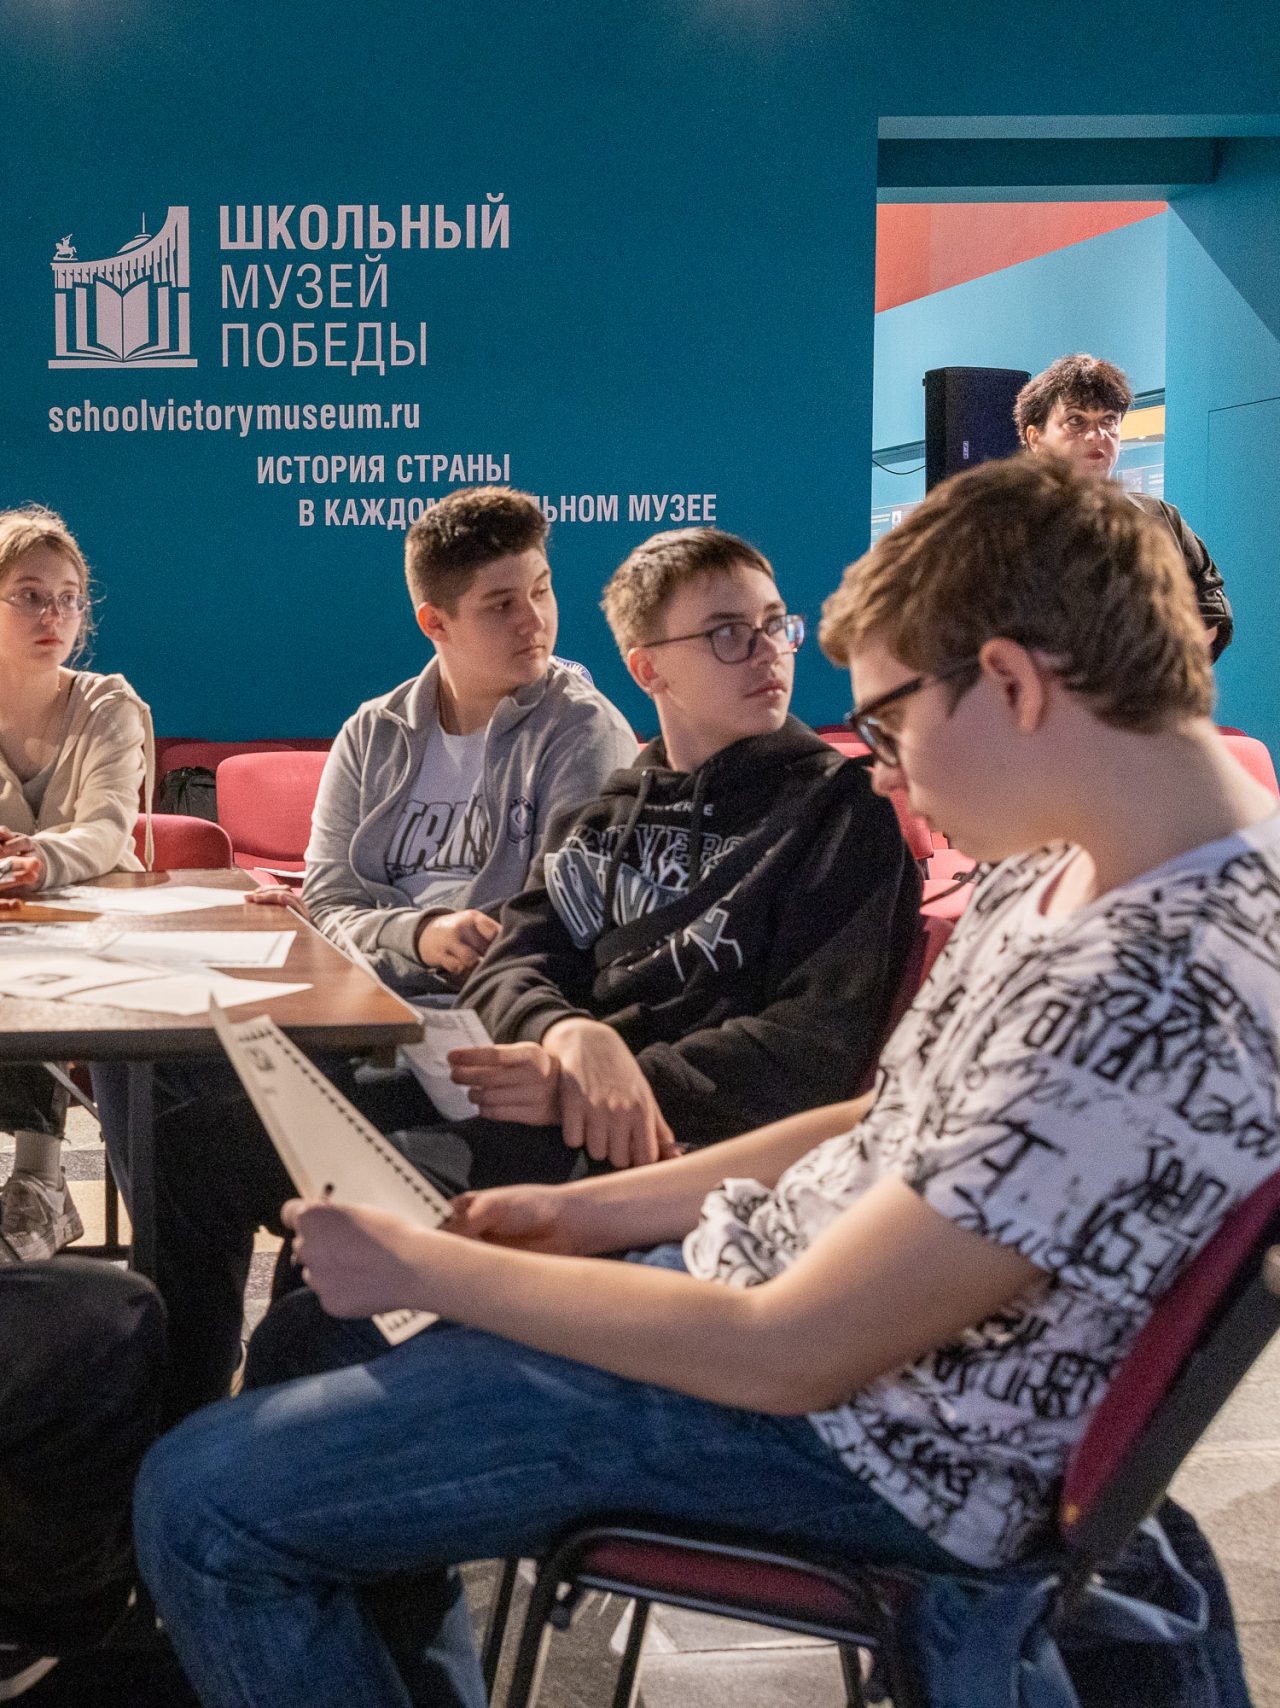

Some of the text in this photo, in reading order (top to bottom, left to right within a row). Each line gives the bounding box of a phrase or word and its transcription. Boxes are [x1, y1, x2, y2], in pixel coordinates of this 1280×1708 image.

[219, 193, 510, 250] ШКОЛЬНЫЙ
[220, 254, 388, 309] МУЗЕЙ
[221, 322, 427, 376] ПОБЕДЫ
[48, 398, 420, 437] schoolvictorymuseum.ru
[257, 453, 511, 485] ИСТОРИЯ СТРАНЫ
[299, 498, 315, 527] В
[628, 493, 717, 522] МУЗЕЕ
